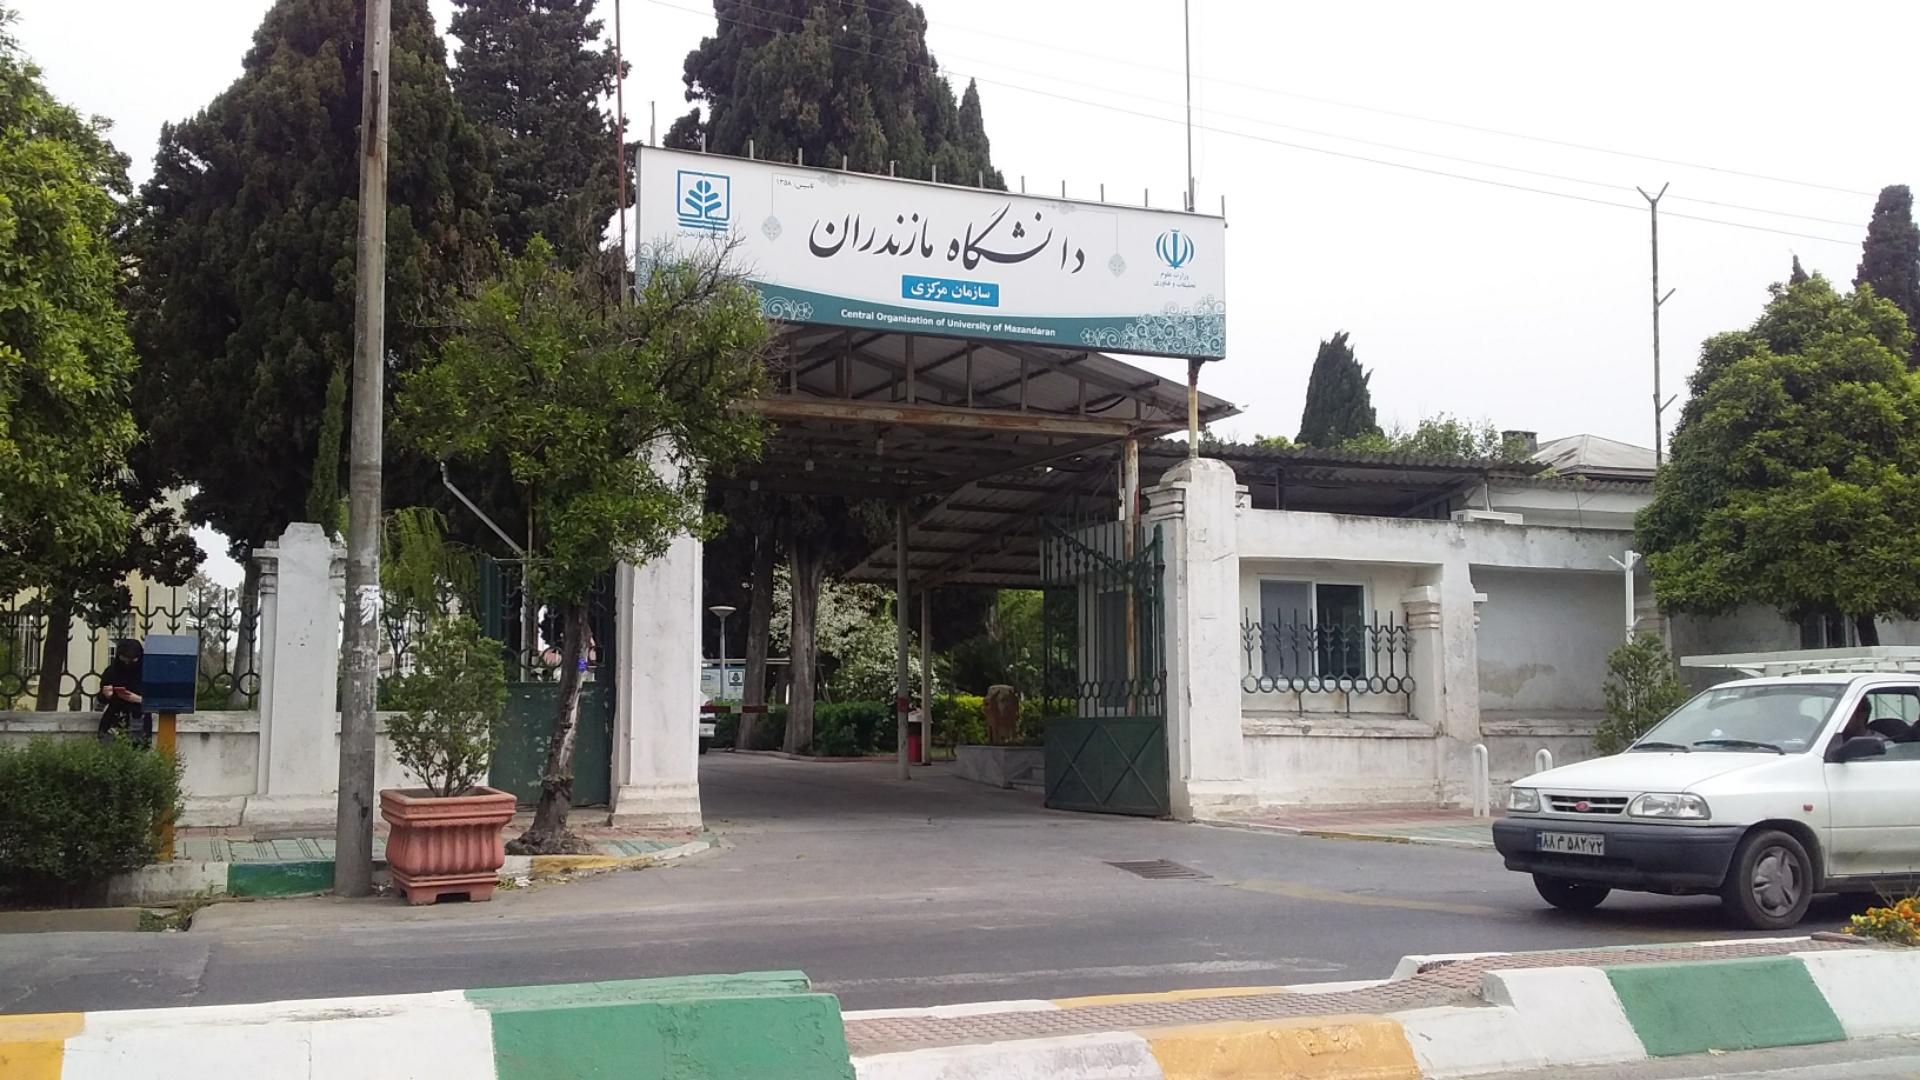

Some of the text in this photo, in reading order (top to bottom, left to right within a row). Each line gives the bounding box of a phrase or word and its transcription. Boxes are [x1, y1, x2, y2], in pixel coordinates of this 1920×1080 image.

[808, 201, 1085, 274] دانشگاه مازندران
[910, 281, 991, 300] سازمان مرکزی
[840, 309, 1056, 337] Central Organization of University of Mazandaran
